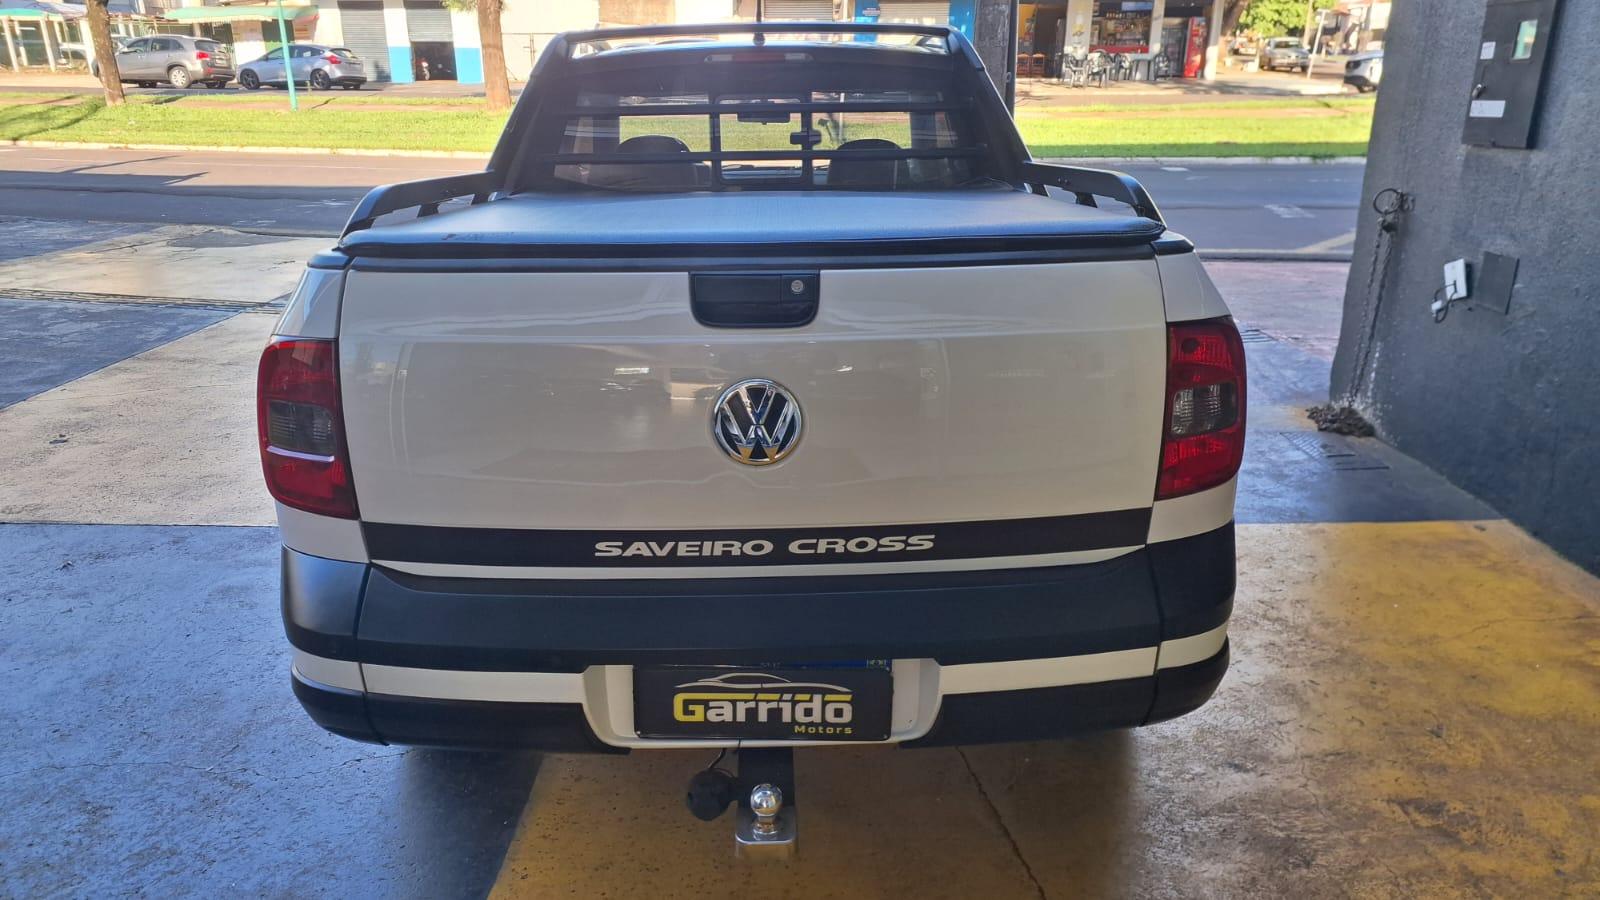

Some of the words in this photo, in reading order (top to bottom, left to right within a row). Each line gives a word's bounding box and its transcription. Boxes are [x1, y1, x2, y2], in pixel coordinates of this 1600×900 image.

[715, 379, 802, 465] VW
[595, 539, 774, 557] SAVEIRO
[788, 534, 936, 555] CROSS
[673, 692, 853, 724] Garrido
[794, 725, 853, 735] Motors
